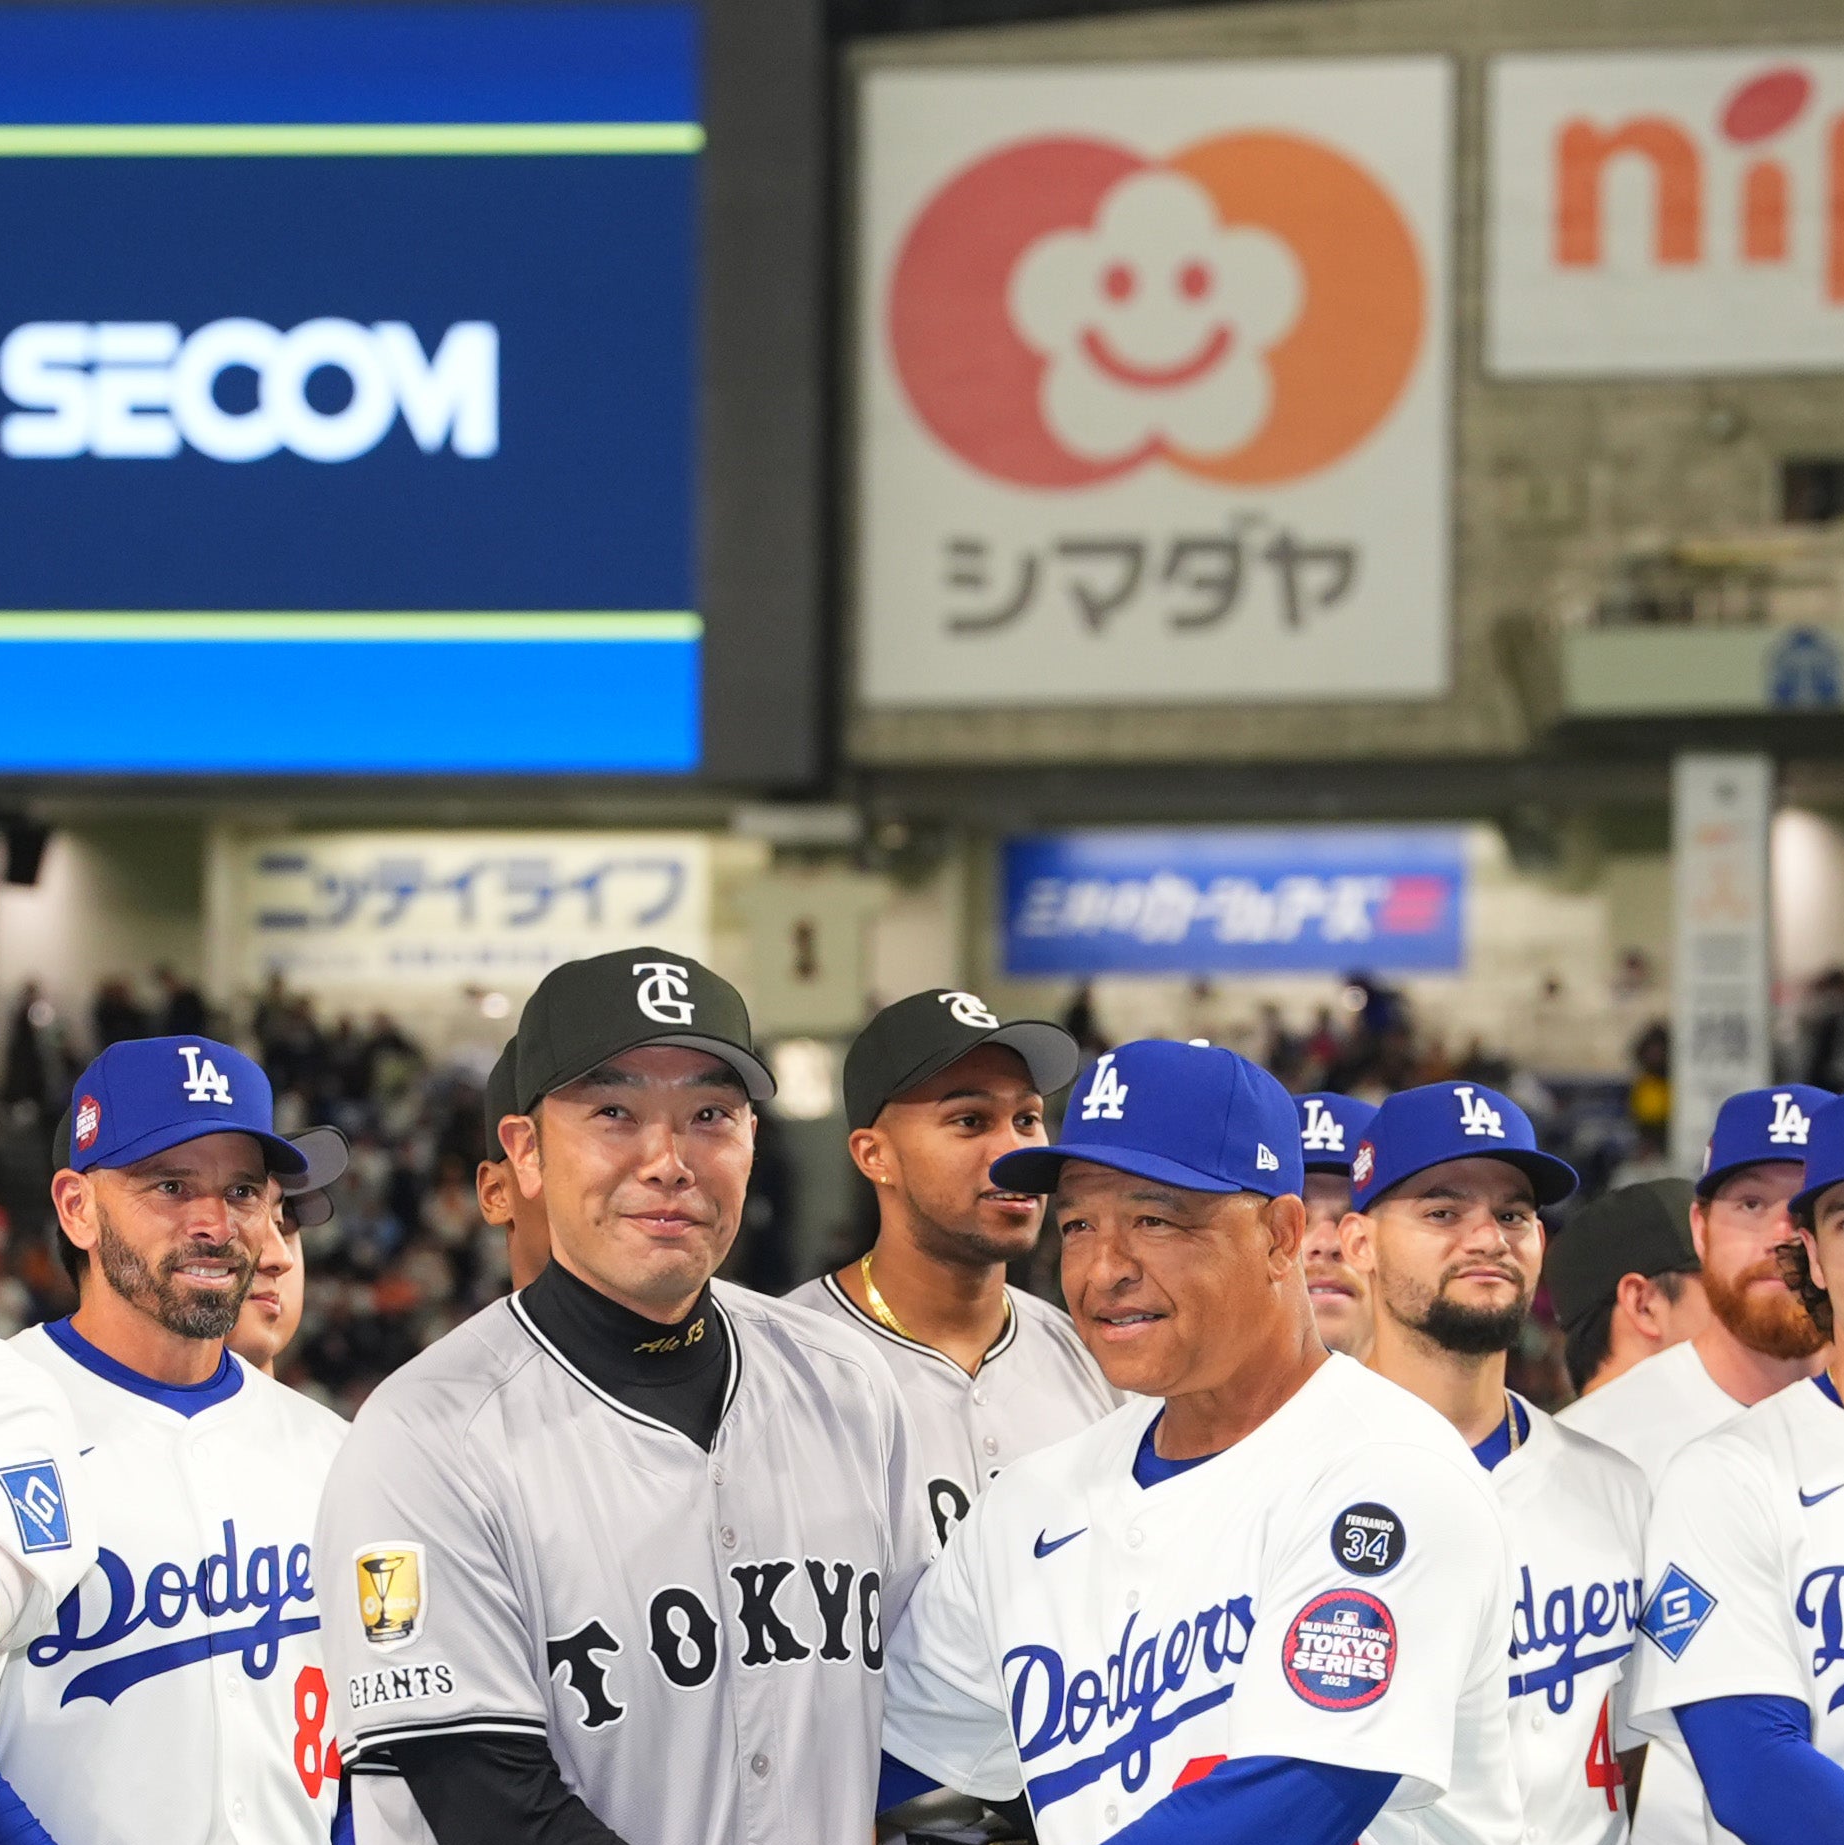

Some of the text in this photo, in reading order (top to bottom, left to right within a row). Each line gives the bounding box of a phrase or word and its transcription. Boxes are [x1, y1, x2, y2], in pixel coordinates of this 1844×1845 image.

[937, 512, 1363, 636] シマダヤ
[177, 1046, 233, 1105] LA
[1081, 1052, 1129, 1121] LA
[1300, 1098, 1346, 1153] LA
[1452, 1086, 1507, 1140] LA
[1768, 1092, 1811, 1145] LA
[684, 1317, 705, 1347] 83
[1342, 1526, 1390, 1567] 34
[1344, 1513, 1395, 1533] FERNANDO
[27, 1519, 319, 1681] Dodge
[546, 1556, 886, 1732] TOKYO
[1298, 1621, 1391, 1645] MLB WORLD TOUR
[1298, 1632, 1387, 1662] TOKYO
[348, 1664, 454, 1710] GIANTS
[1292, 1650, 1387, 1681] SERIES
[1320, 1674, 1351, 1689] 2025
[1002, 1593, 1256, 1795] Dodgers
[294, 1665, 342, 1799] 8
